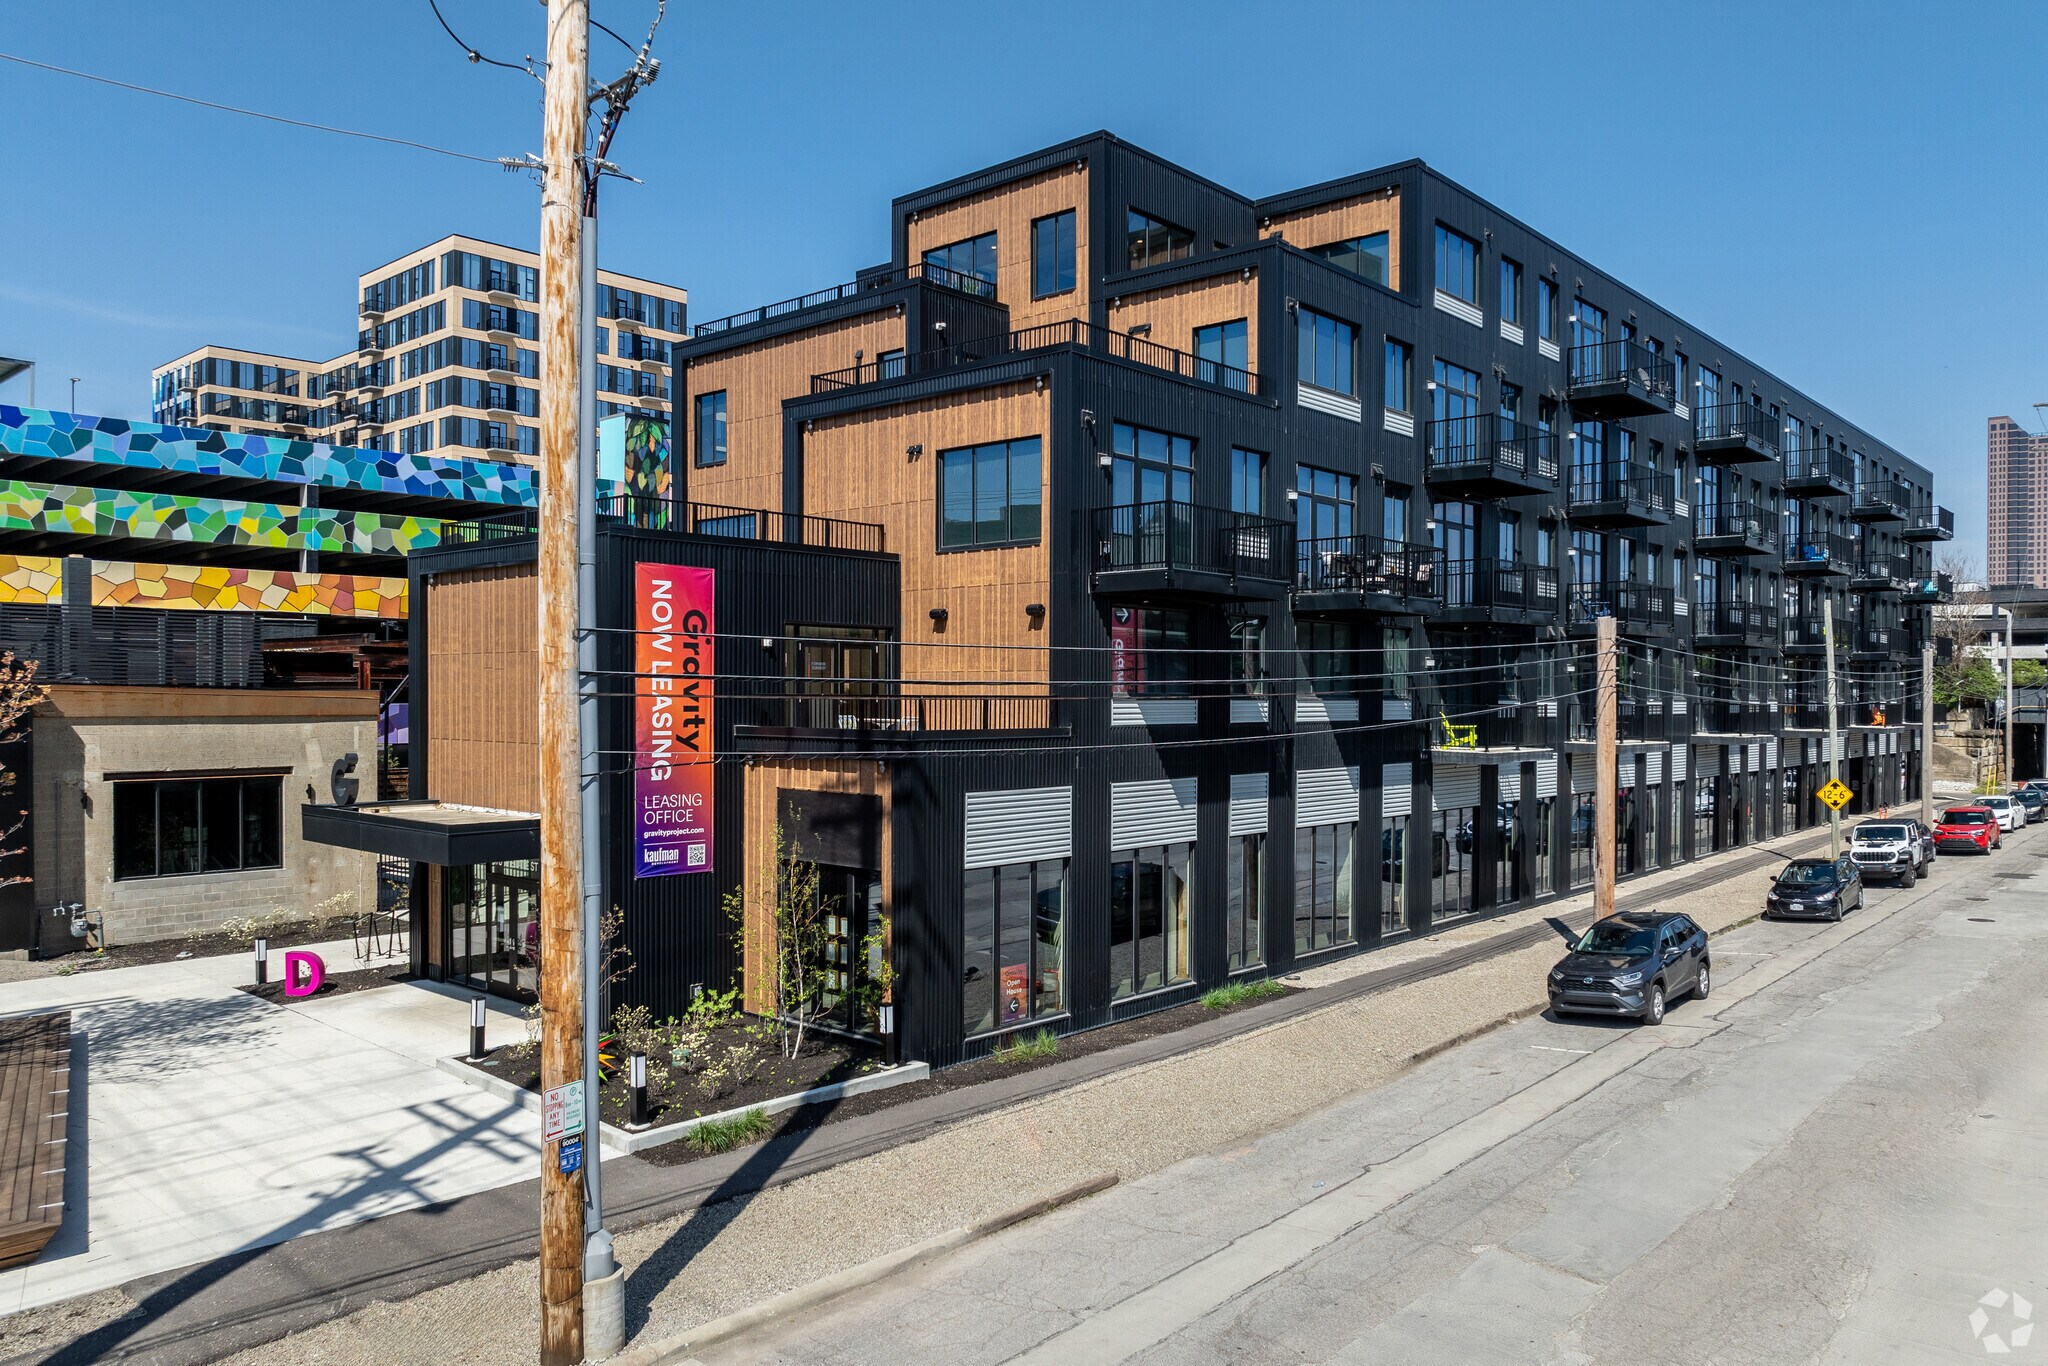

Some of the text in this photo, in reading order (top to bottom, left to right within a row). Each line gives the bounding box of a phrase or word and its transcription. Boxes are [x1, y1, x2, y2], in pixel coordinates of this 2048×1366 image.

[651, 579, 673, 781] NOW LEASING
[676, 609, 708, 752] Gravity
[644, 793, 703, 809] LEASING
[644, 809, 694, 825] OFFICE
[643, 827, 705, 839] gravityproject.com
[644, 847, 679, 863] kaufman
[285, 951, 326, 996] D
[550, 1092, 559, 1102] NO
[546, 1100, 564, 1113] STOPPING
[549, 1118, 561, 1128] TIME
[550, 1111, 560, 1120] ANY
